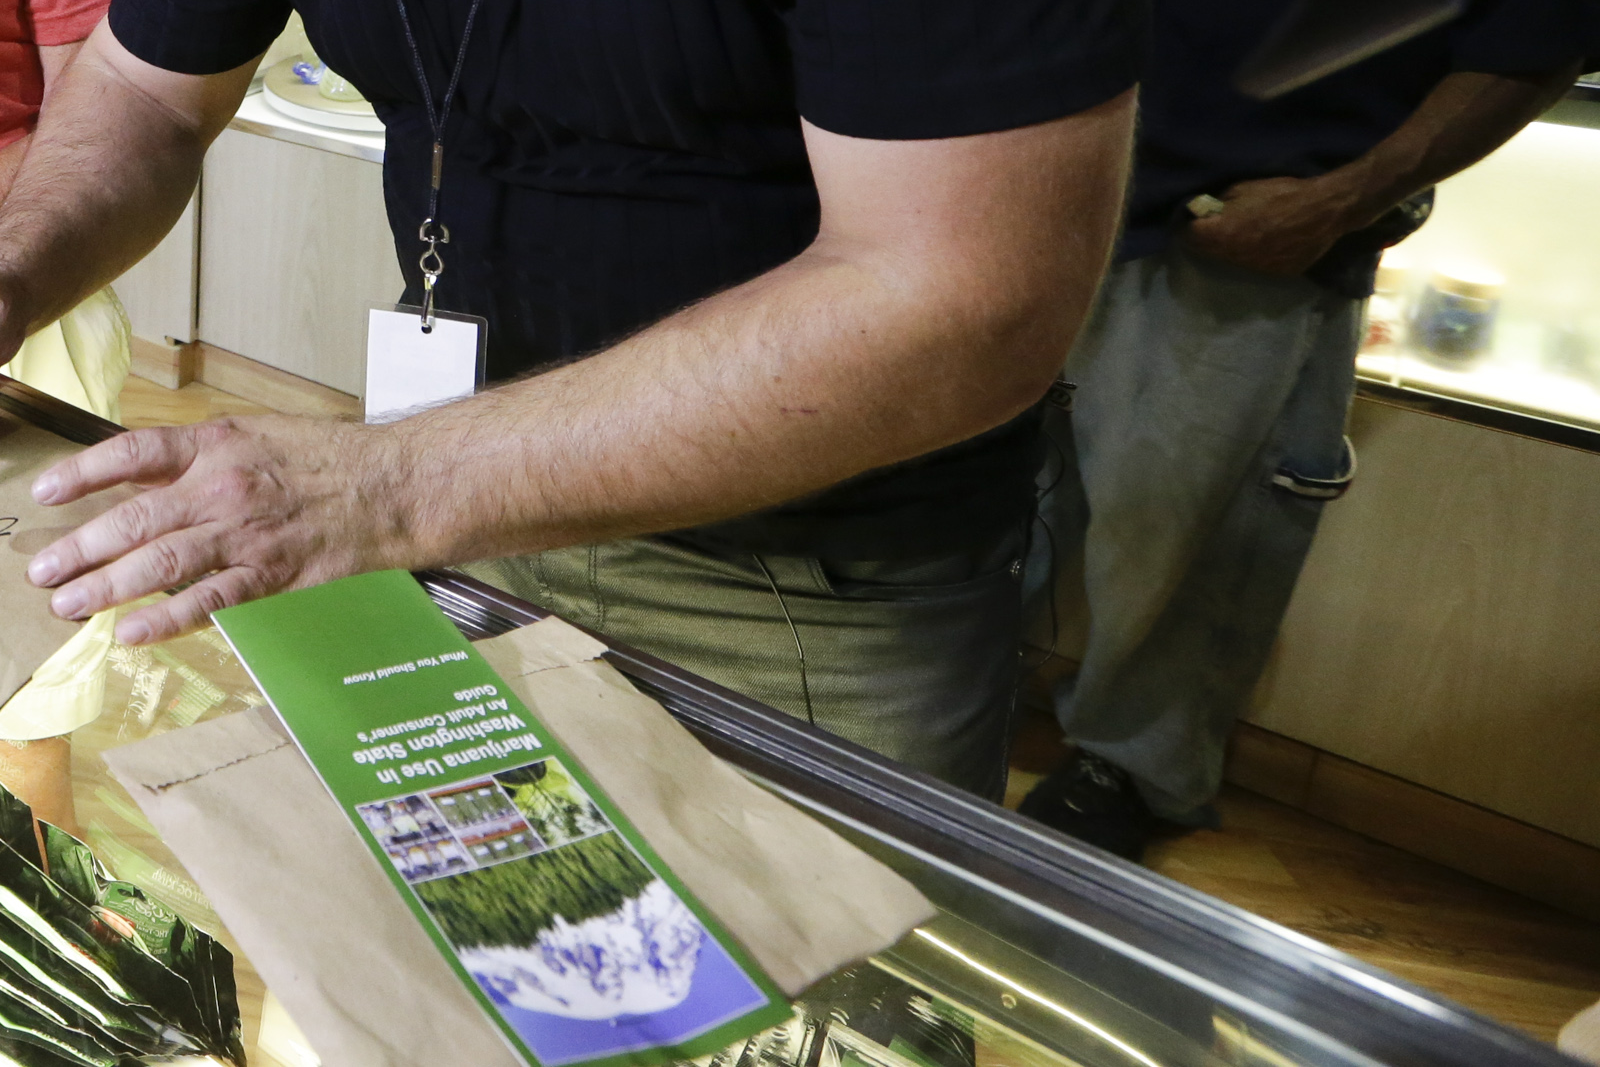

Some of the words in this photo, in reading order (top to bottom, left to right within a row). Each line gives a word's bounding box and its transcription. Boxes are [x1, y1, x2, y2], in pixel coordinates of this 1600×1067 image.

[416, 656, 440, 668] You
[438, 650, 469, 663] What
[342, 670, 376, 685] Know
[376, 661, 416, 678] Should
[453, 684, 498, 702] Guide
[445, 703, 486, 724] Adult
[486, 698, 509, 711] An
[356, 714, 447, 743] Consumer's
[406, 714, 527, 752] Washington
[352, 742, 408, 765] State
[442, 733, 543, 768] Marijuana
[376, 768, 402, 784] in
[401, 758, 445, 779] Use
